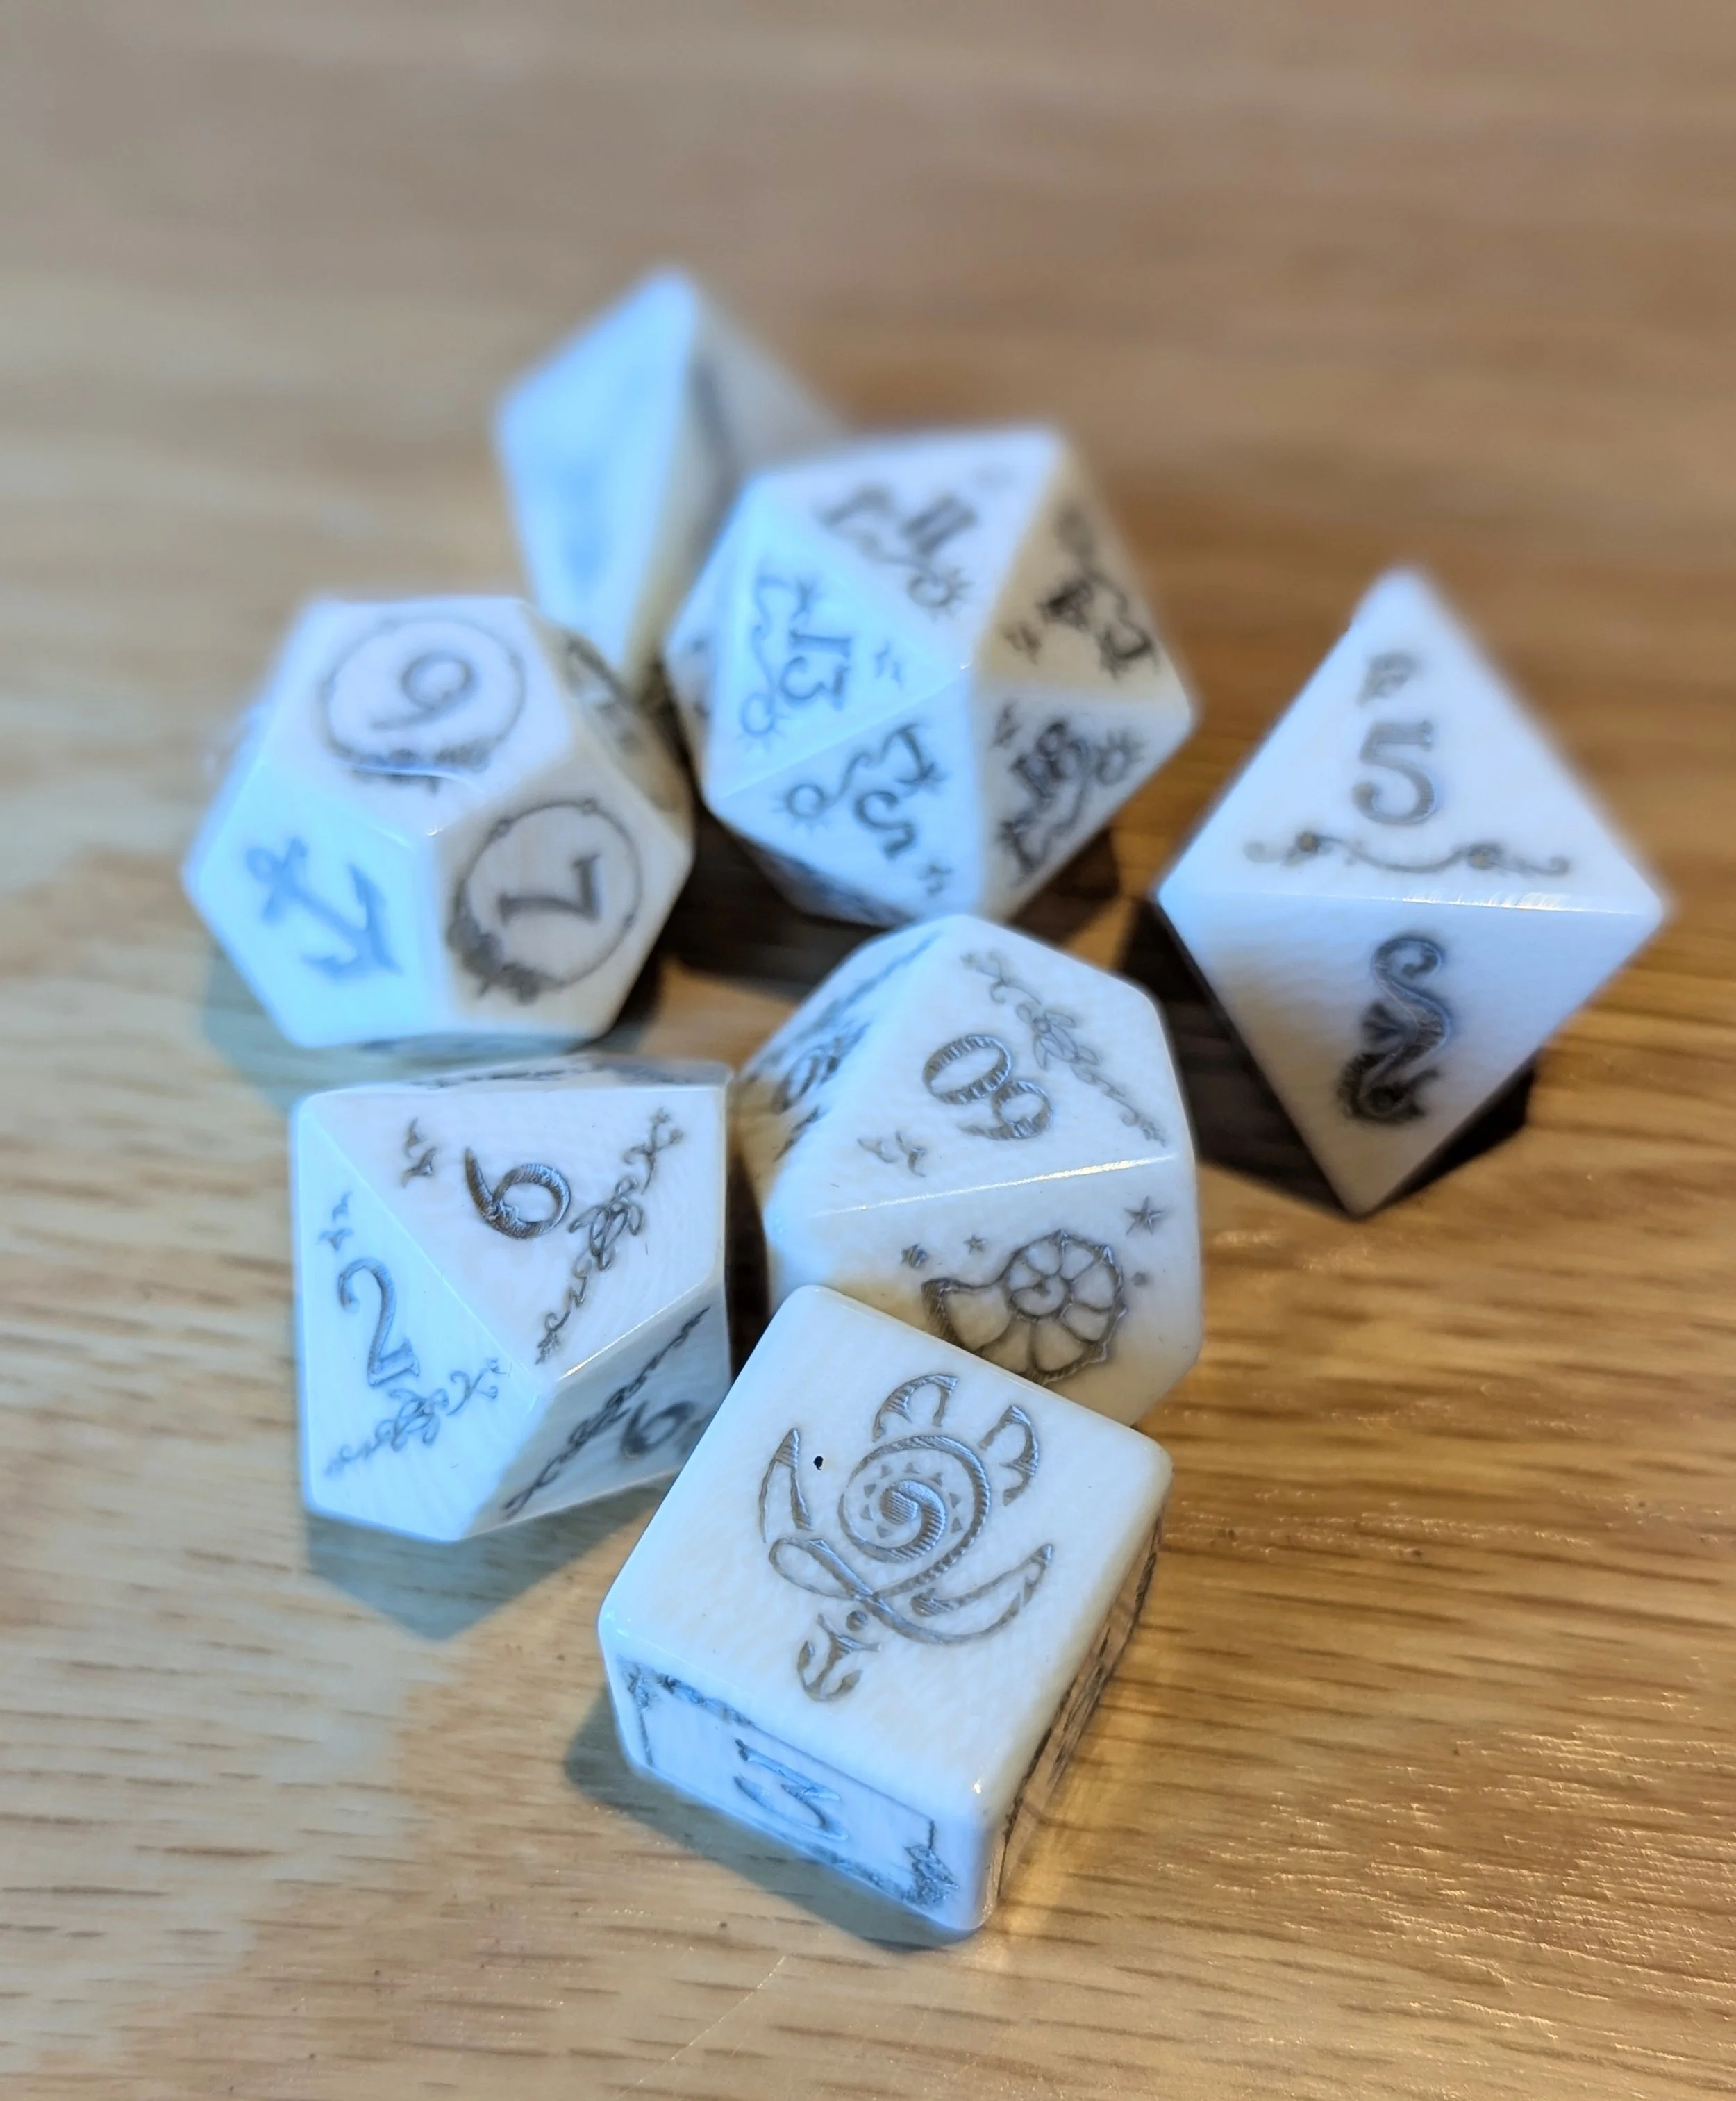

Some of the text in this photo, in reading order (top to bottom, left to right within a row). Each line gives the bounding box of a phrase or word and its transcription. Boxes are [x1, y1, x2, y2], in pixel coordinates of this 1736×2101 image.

[779, 627, 853, 712] 13
[1351, 720, 1437, 826] 5
[497, 852, 601, 929] 7
[464, 1146, 572, 1240] 6
[337, 1257, 420, 1388] 2
[733, 1738, 849, 1842] 3
